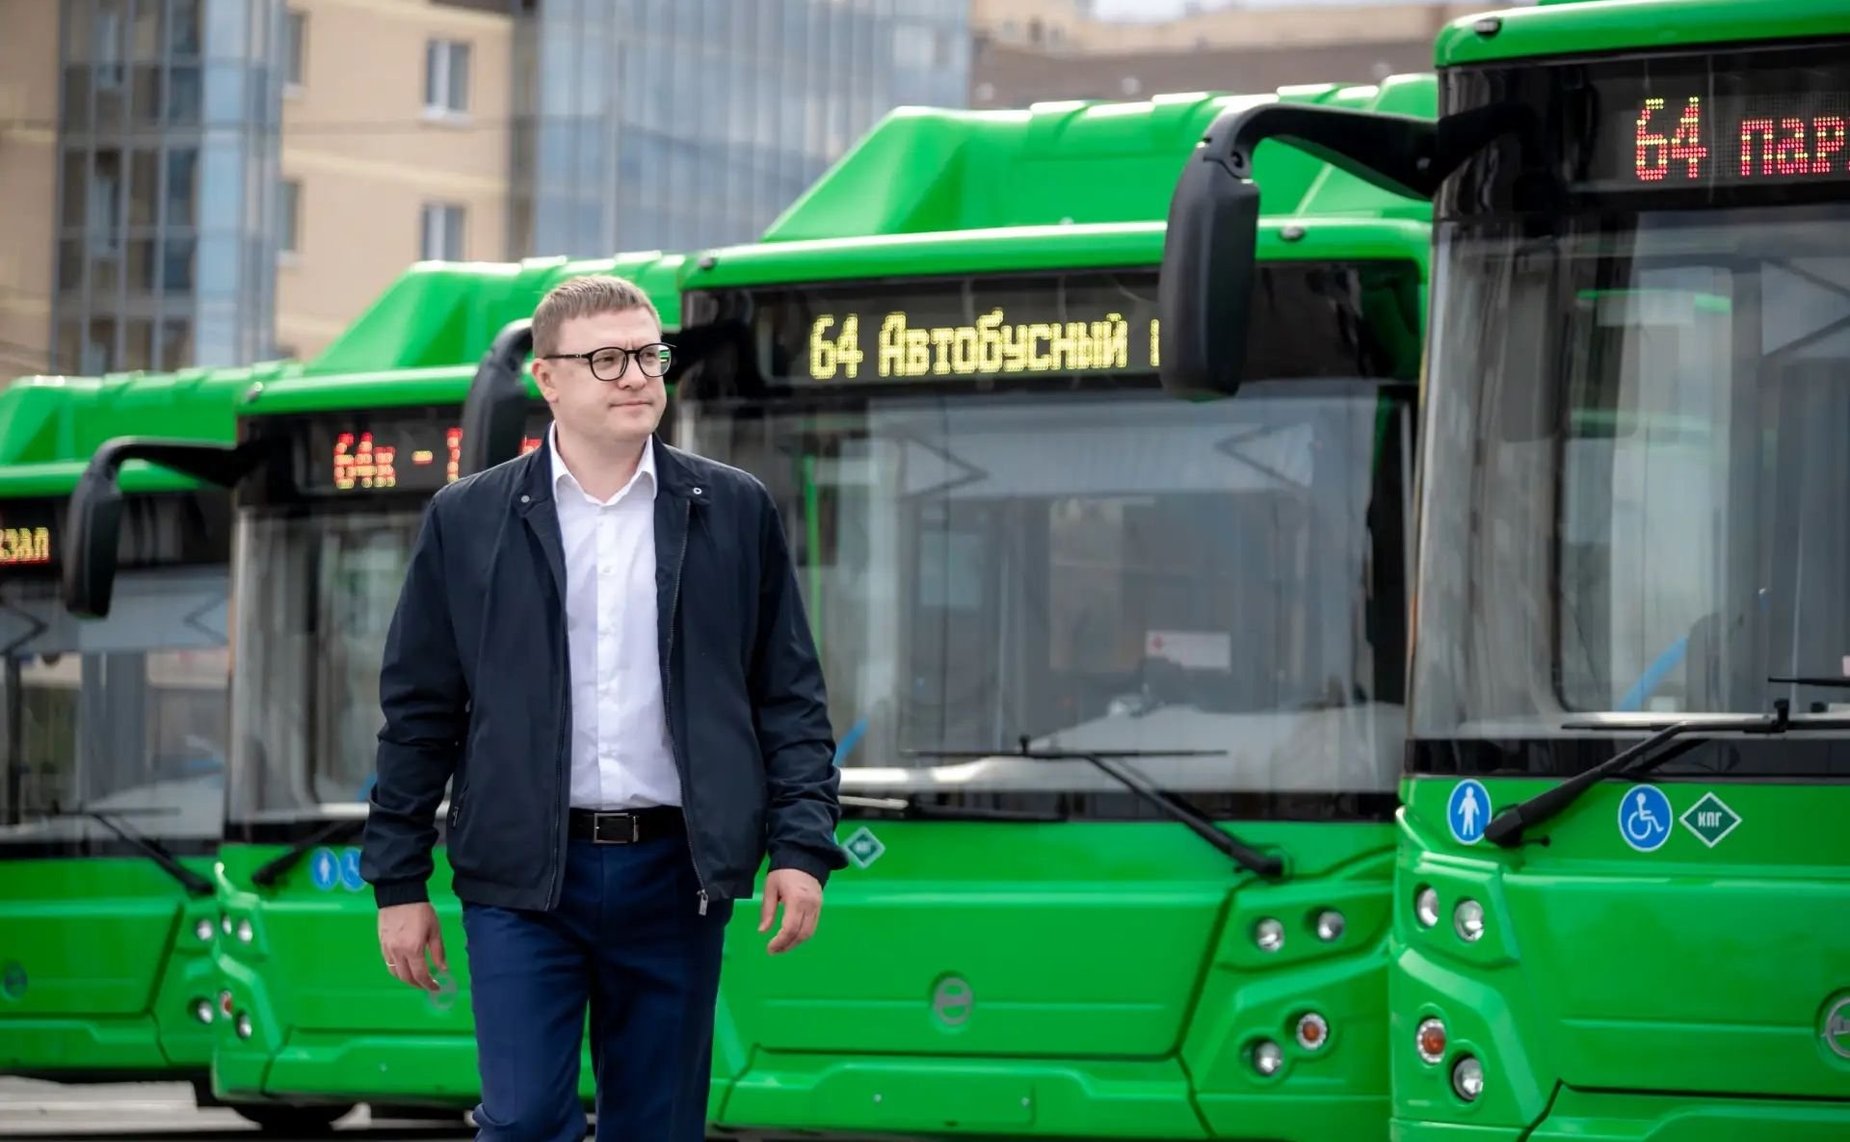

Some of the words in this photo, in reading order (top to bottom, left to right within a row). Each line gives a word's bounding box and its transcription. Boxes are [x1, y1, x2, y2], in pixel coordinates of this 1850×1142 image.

[1636, 97, 1707, 180] 64
[1741, 115, 1850, 176] пар
[810, 313, 863, 379] 64
[879, 307, 1127, 377] Автобусный
[0, 527, 49, 563] зал
[1698, 811, 1722, 828] КПГ
